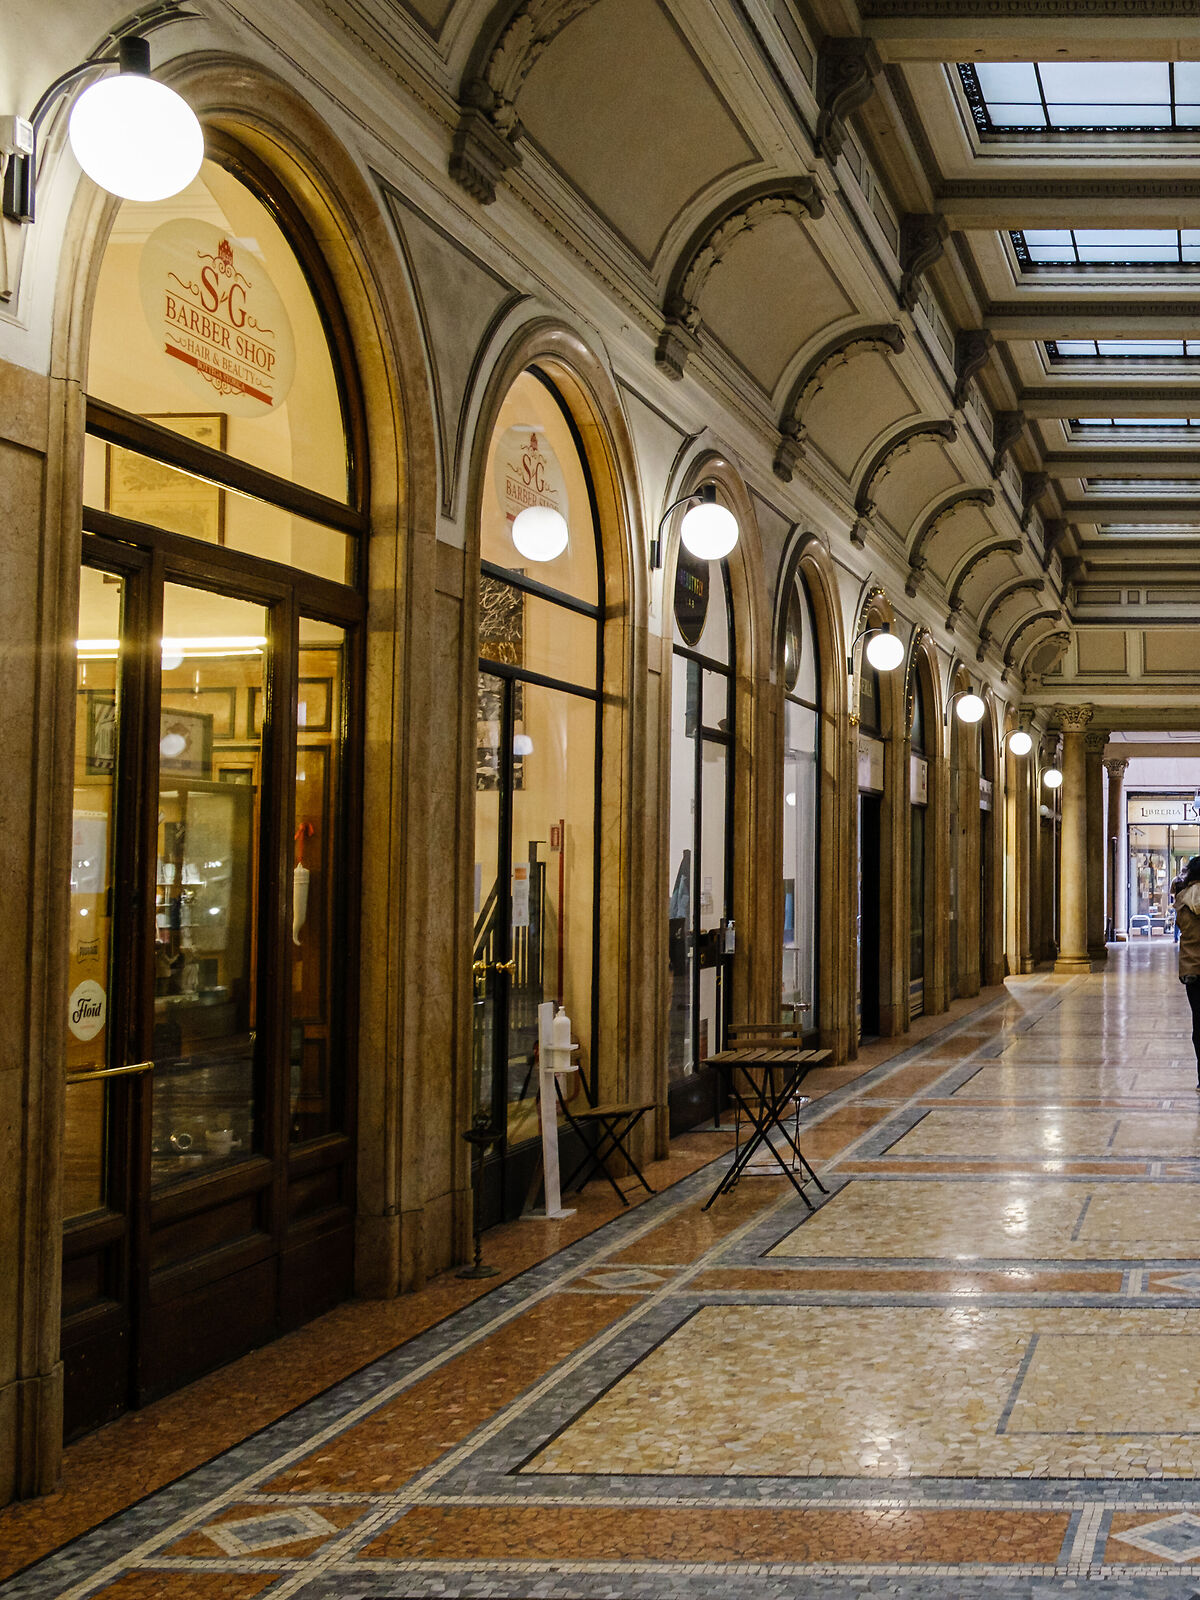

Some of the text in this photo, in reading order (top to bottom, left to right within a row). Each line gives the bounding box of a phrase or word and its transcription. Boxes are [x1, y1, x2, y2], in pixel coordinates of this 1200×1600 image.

[166, 295, 276, 372] BARBER SHOP
[187, 338, 257, 384] HAIR & BEAUTY
[506, 479, 537, 507] BARBER
[1141, 807, 1181, 817] LIBRERIA
